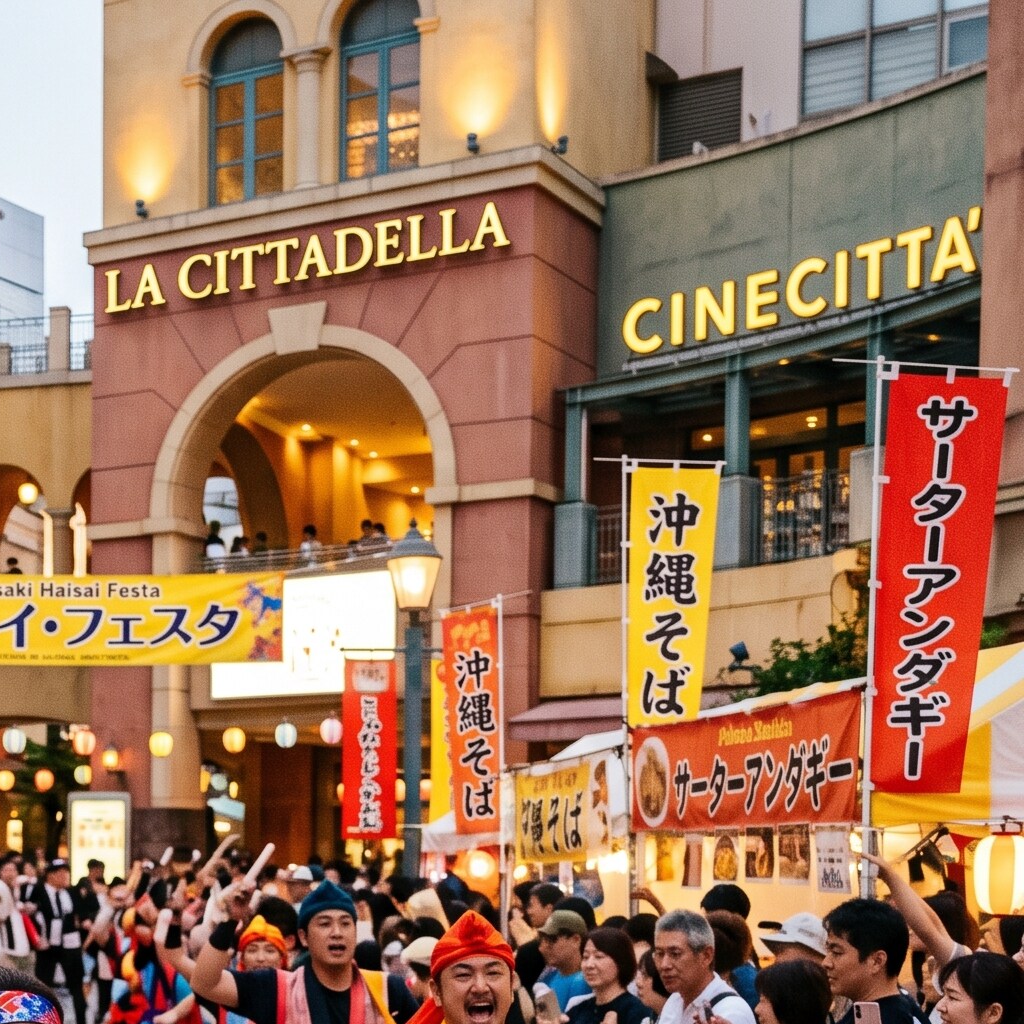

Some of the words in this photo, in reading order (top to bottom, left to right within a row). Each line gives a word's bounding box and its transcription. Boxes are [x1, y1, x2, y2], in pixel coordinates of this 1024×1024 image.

[104, 263, 166, 316] LA
[177, 201, 512, 300] CITTADELLA
[40, 580, 101, 598] Haisai
[107, 581, 161, 598] Festa
[643, 492, 700, 716] 沖縄そば
[889, 397, 977, 780] サーターアンダギー
[455, 649, 495, 819] 沖縄そば
[674, 736, 853, 818] サーターアンダギー
